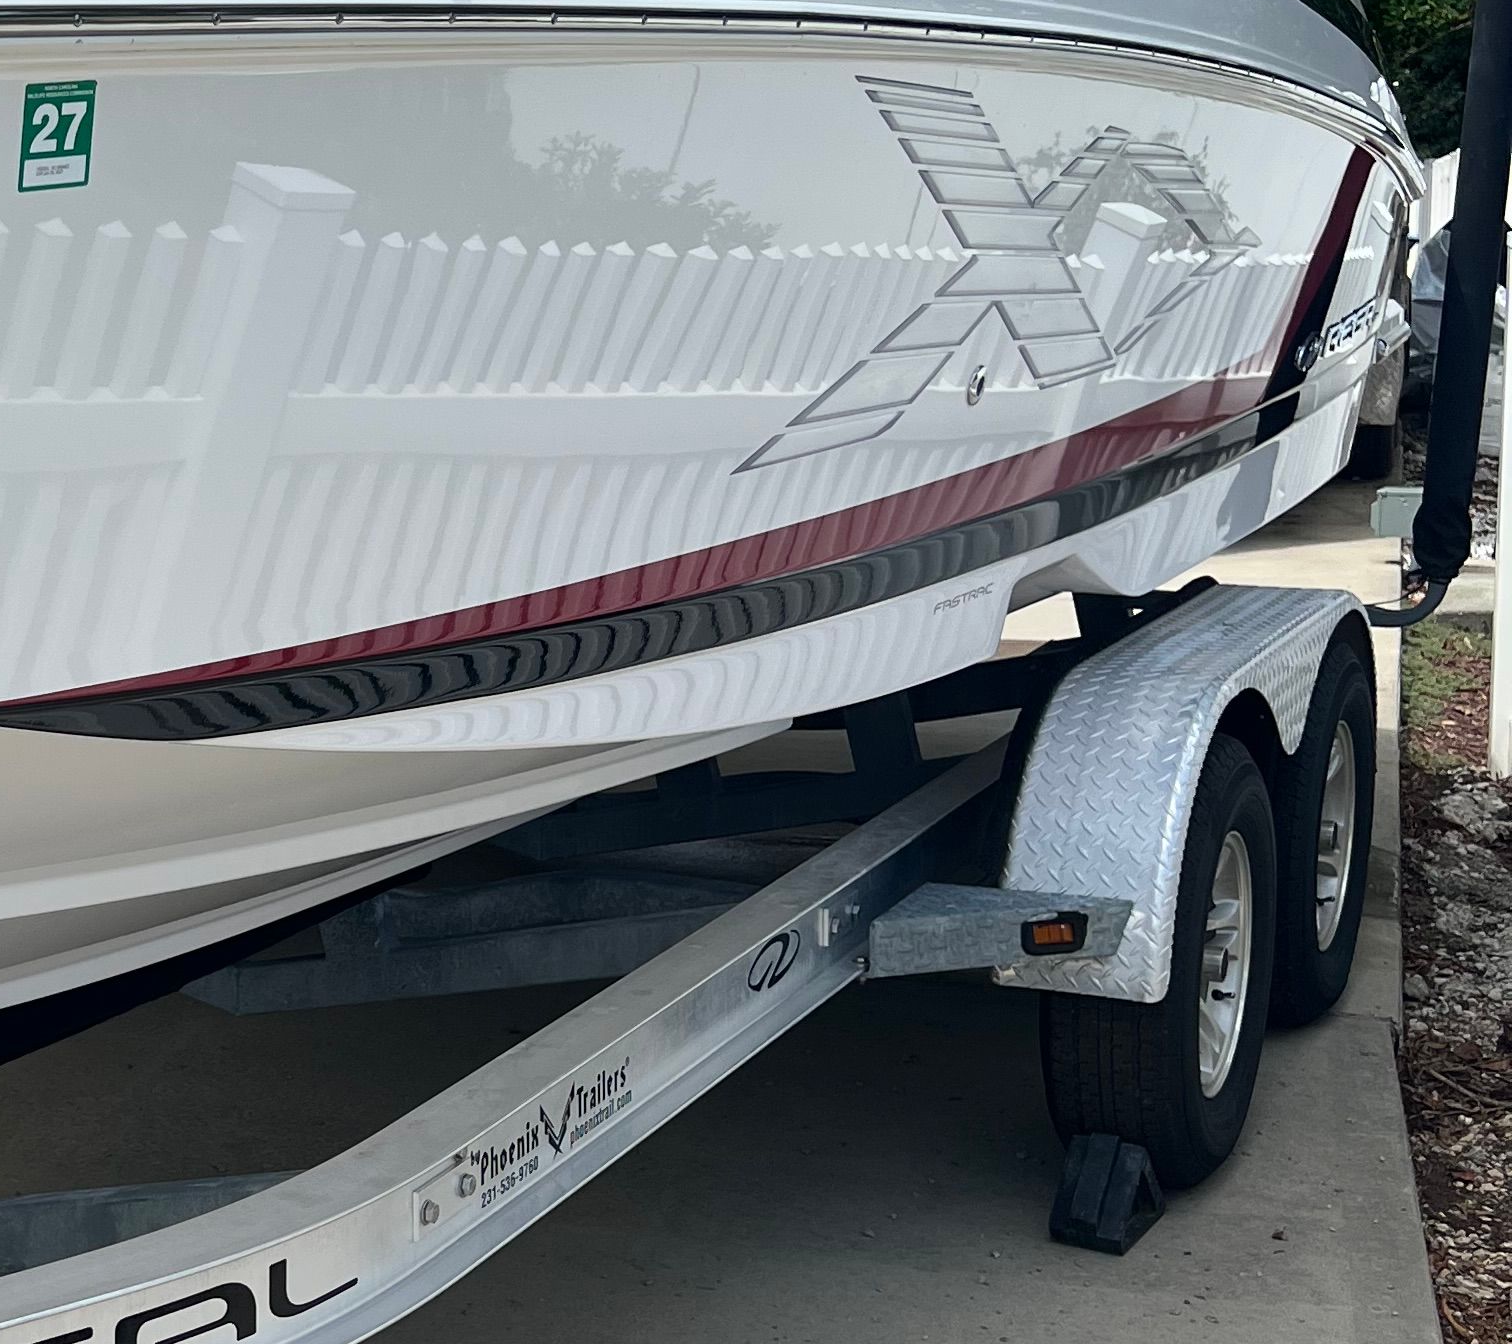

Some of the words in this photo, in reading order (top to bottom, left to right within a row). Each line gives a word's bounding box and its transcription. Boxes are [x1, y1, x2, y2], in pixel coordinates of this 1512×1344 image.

[29, 100, 88, 154] 27
[932, 582, 995, 616] FASTRAC
[480, 1121, 540, 1186] Phoenix
[481, 1155, 539, 1208] 231-536-9760
[569, 1089, 632, 1149] phoenixtrail.com
